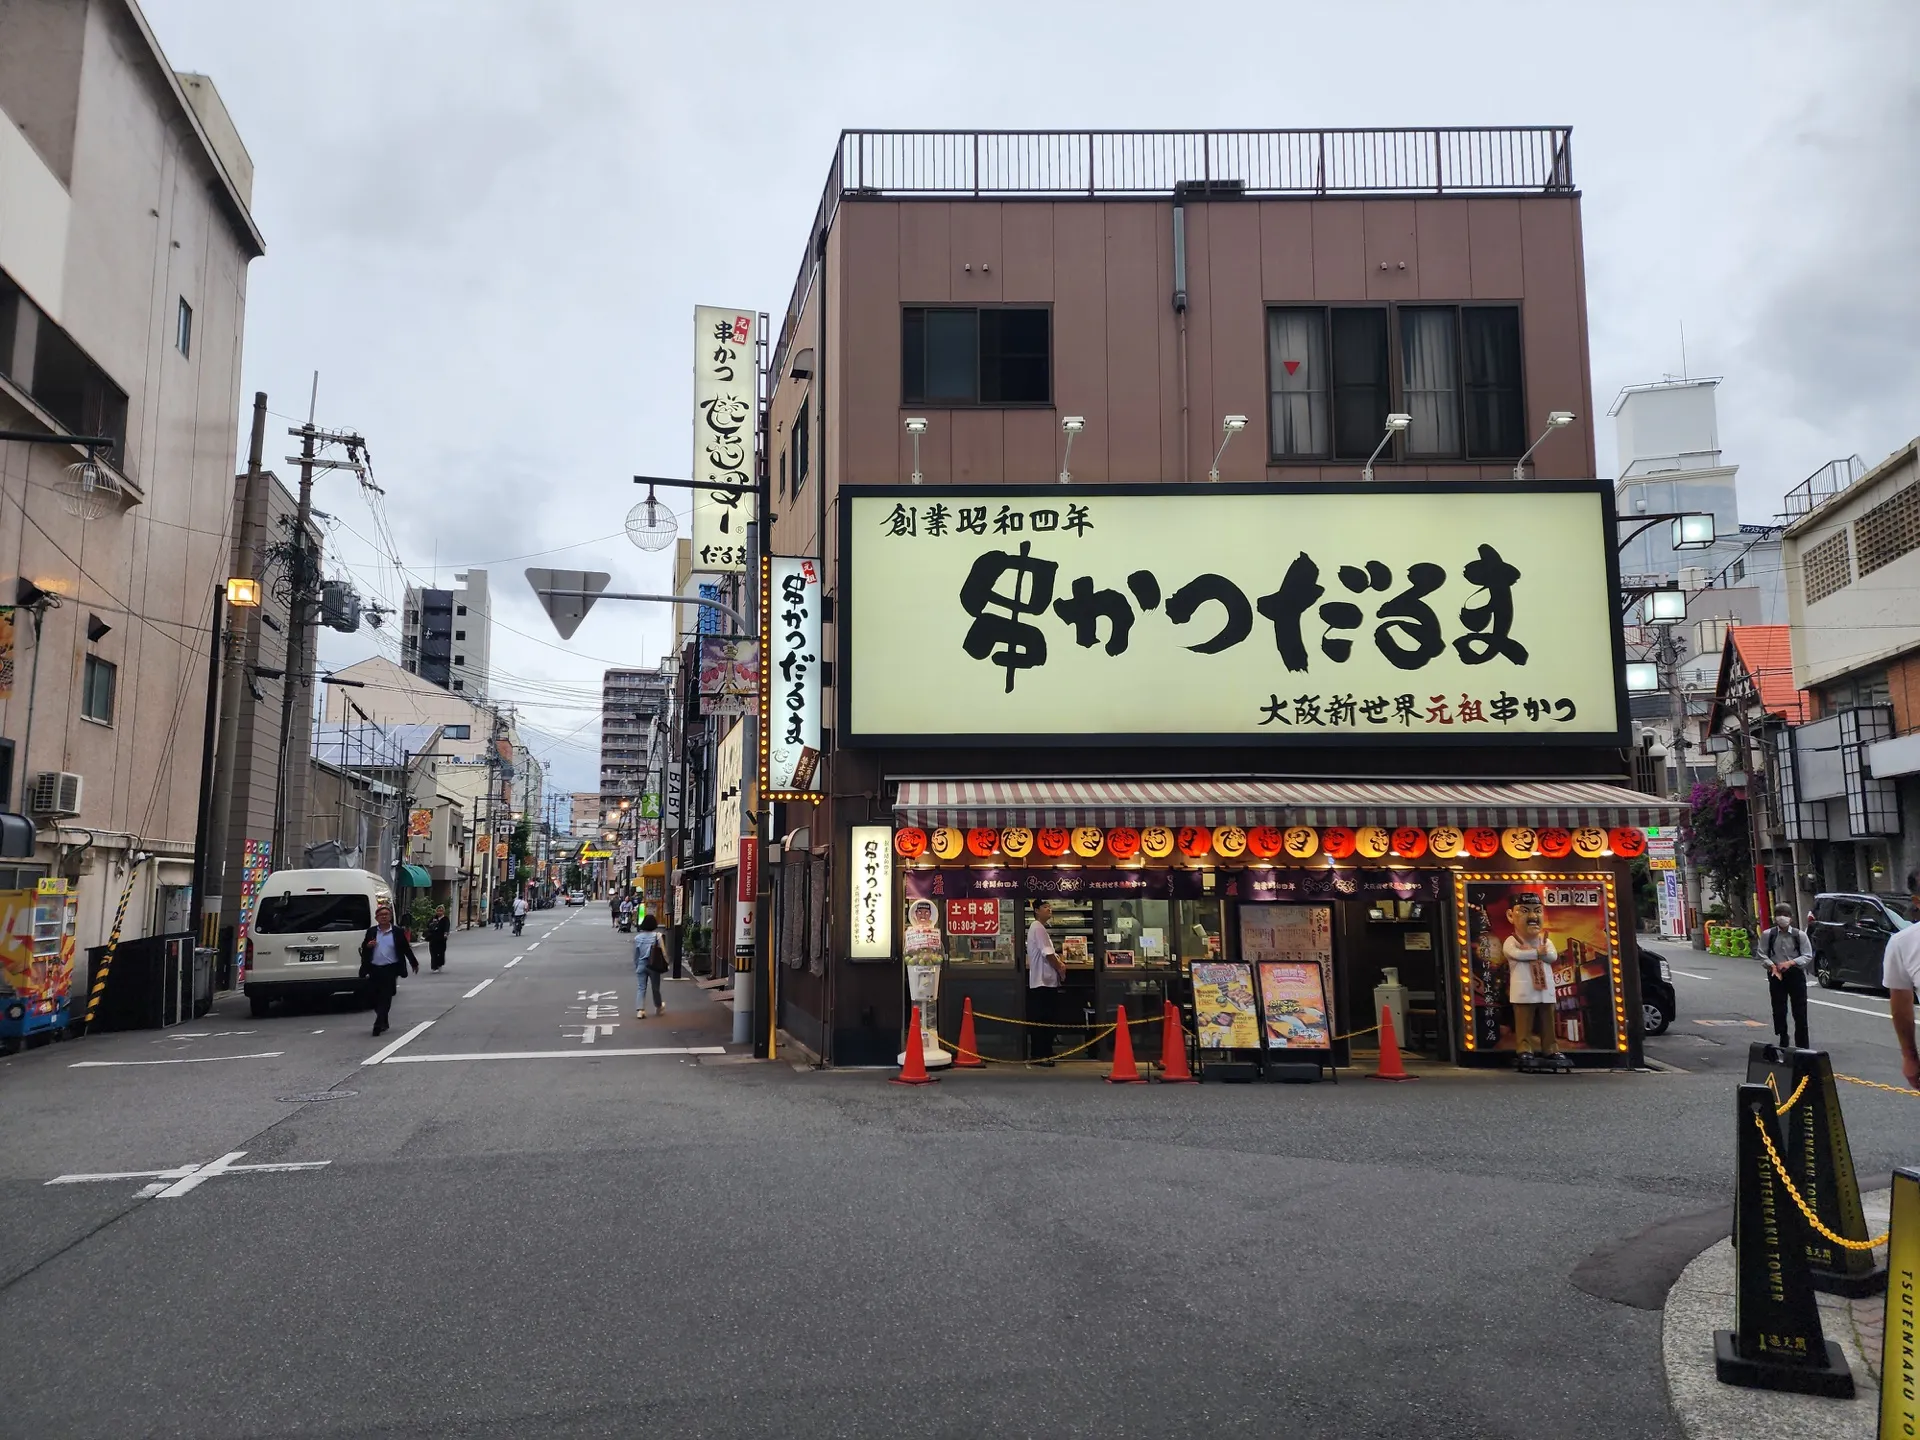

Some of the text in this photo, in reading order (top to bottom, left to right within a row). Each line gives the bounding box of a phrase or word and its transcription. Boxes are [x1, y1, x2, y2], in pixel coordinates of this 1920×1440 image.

[713, 320, 736, 382] 串かつ
[734, 319, 748, 343] 元祖
[879, 503, 1095, 538] 創業昭和四年
[803, 563, 817, 583] 元祖
[959, 541, 1529, 692] 串かつだるま
[779, 573, 815, 745] 串かつだるま
[1257, 691, 1577, 727] 大阪新世界元祖串かつ
[668, 771, 681, 819] BABY
[863, 840, 882, 943] 串かつだるま
[951, 903, 994, 915] 土・日・祝
[949, 920, 998, 931] 10:30オープン
[1756, 1155, 1783, 1302] TSUTENKAKU TOWER
[1902, 1270, 1914, 1401] TSUTENKAKU
